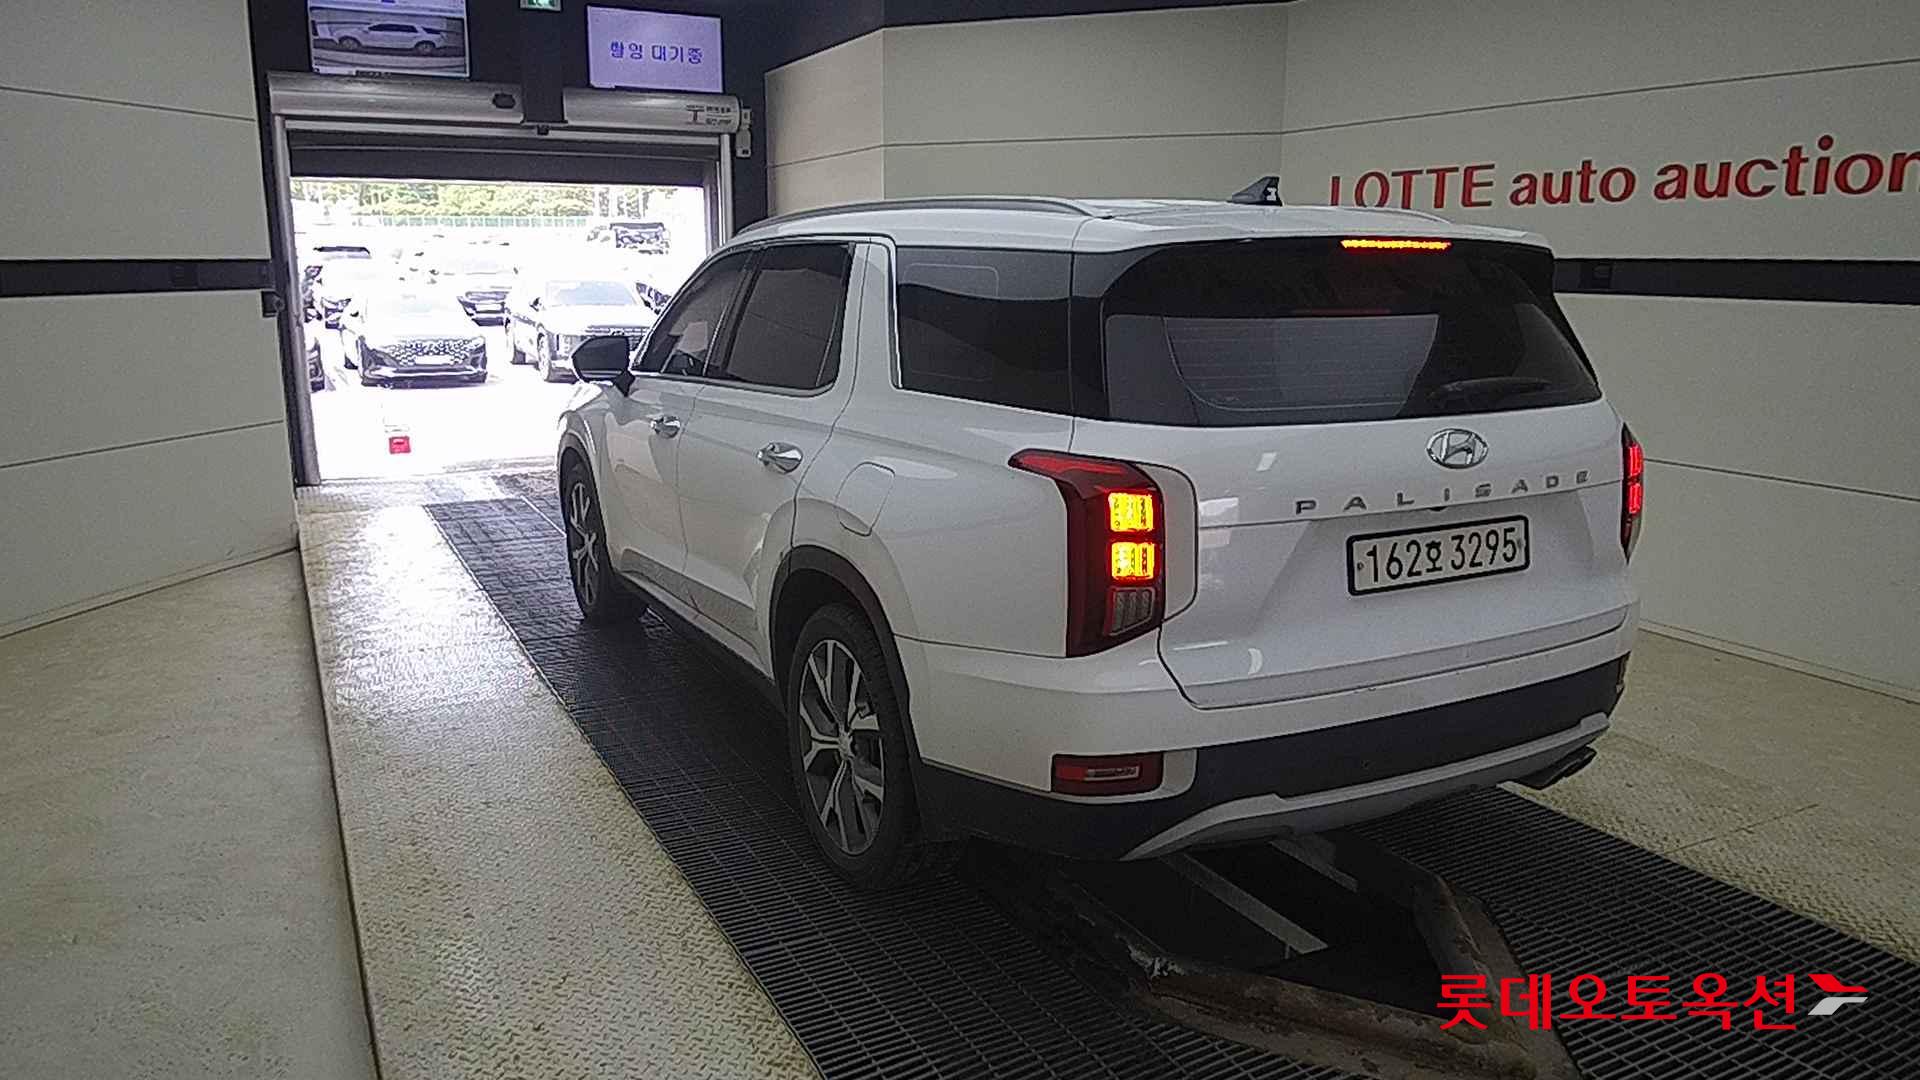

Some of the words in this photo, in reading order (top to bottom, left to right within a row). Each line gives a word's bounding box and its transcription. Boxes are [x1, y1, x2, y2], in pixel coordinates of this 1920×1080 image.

[651, 44, 703, 65] 대기중
[1509, 159, 1636, 206] auto
[1653, 134, 1920, 200] auction
[1295, 470, 1591, 516] PALISADE
